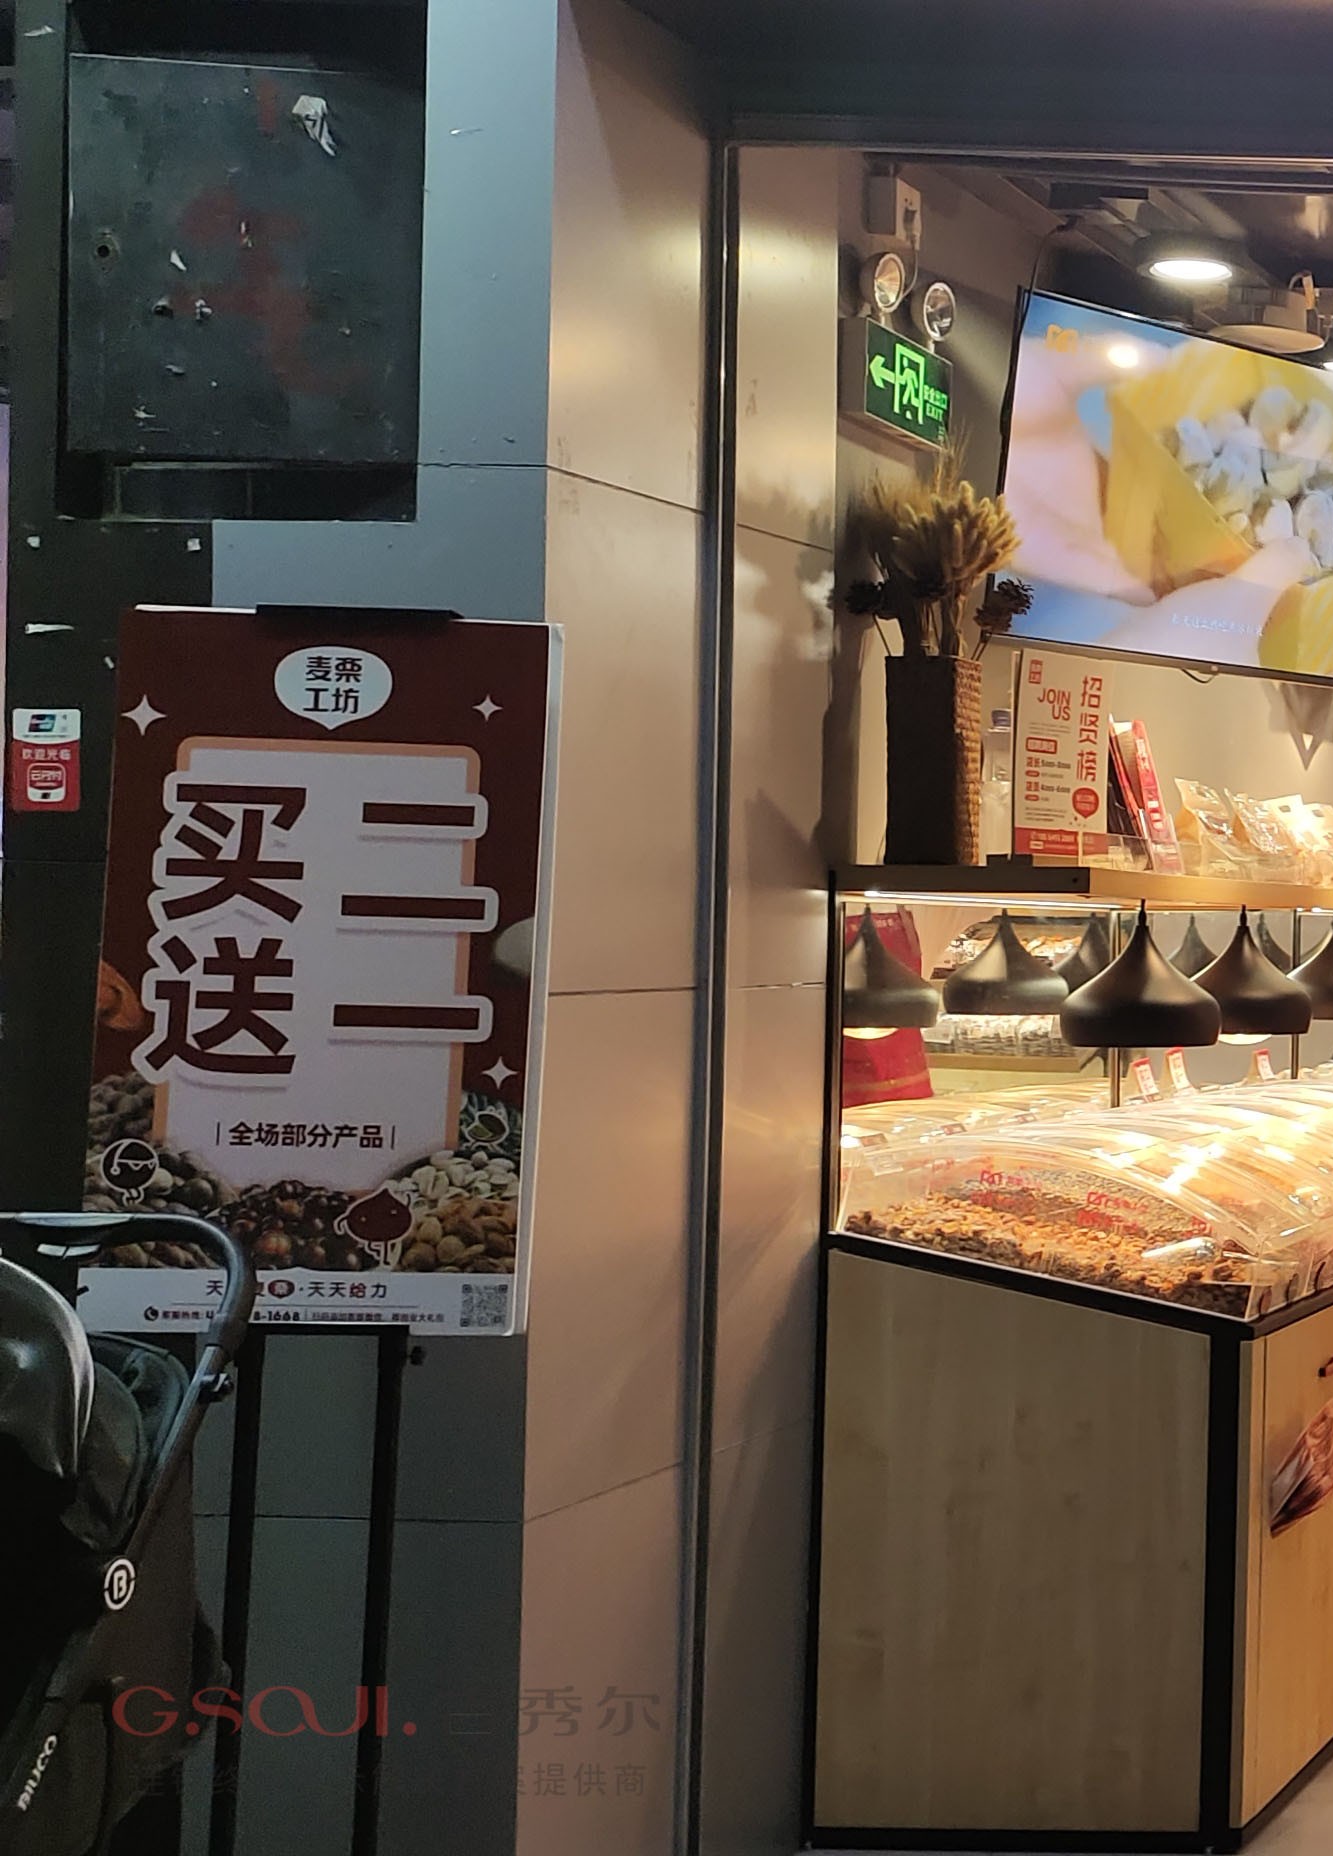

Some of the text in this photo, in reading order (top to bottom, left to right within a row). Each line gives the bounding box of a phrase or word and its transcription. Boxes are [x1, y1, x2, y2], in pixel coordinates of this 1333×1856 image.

[304, 656, 363, 684] 麦栗
[302, 688, 360, 715] 工坊
[1037, 688, 1071, 707] JOIN
[1051, 705, 1071, 721] US
[1077, 675, 1103, 783] 招贤榜
[228, 1122, 384, 1150] 全场部分产品
